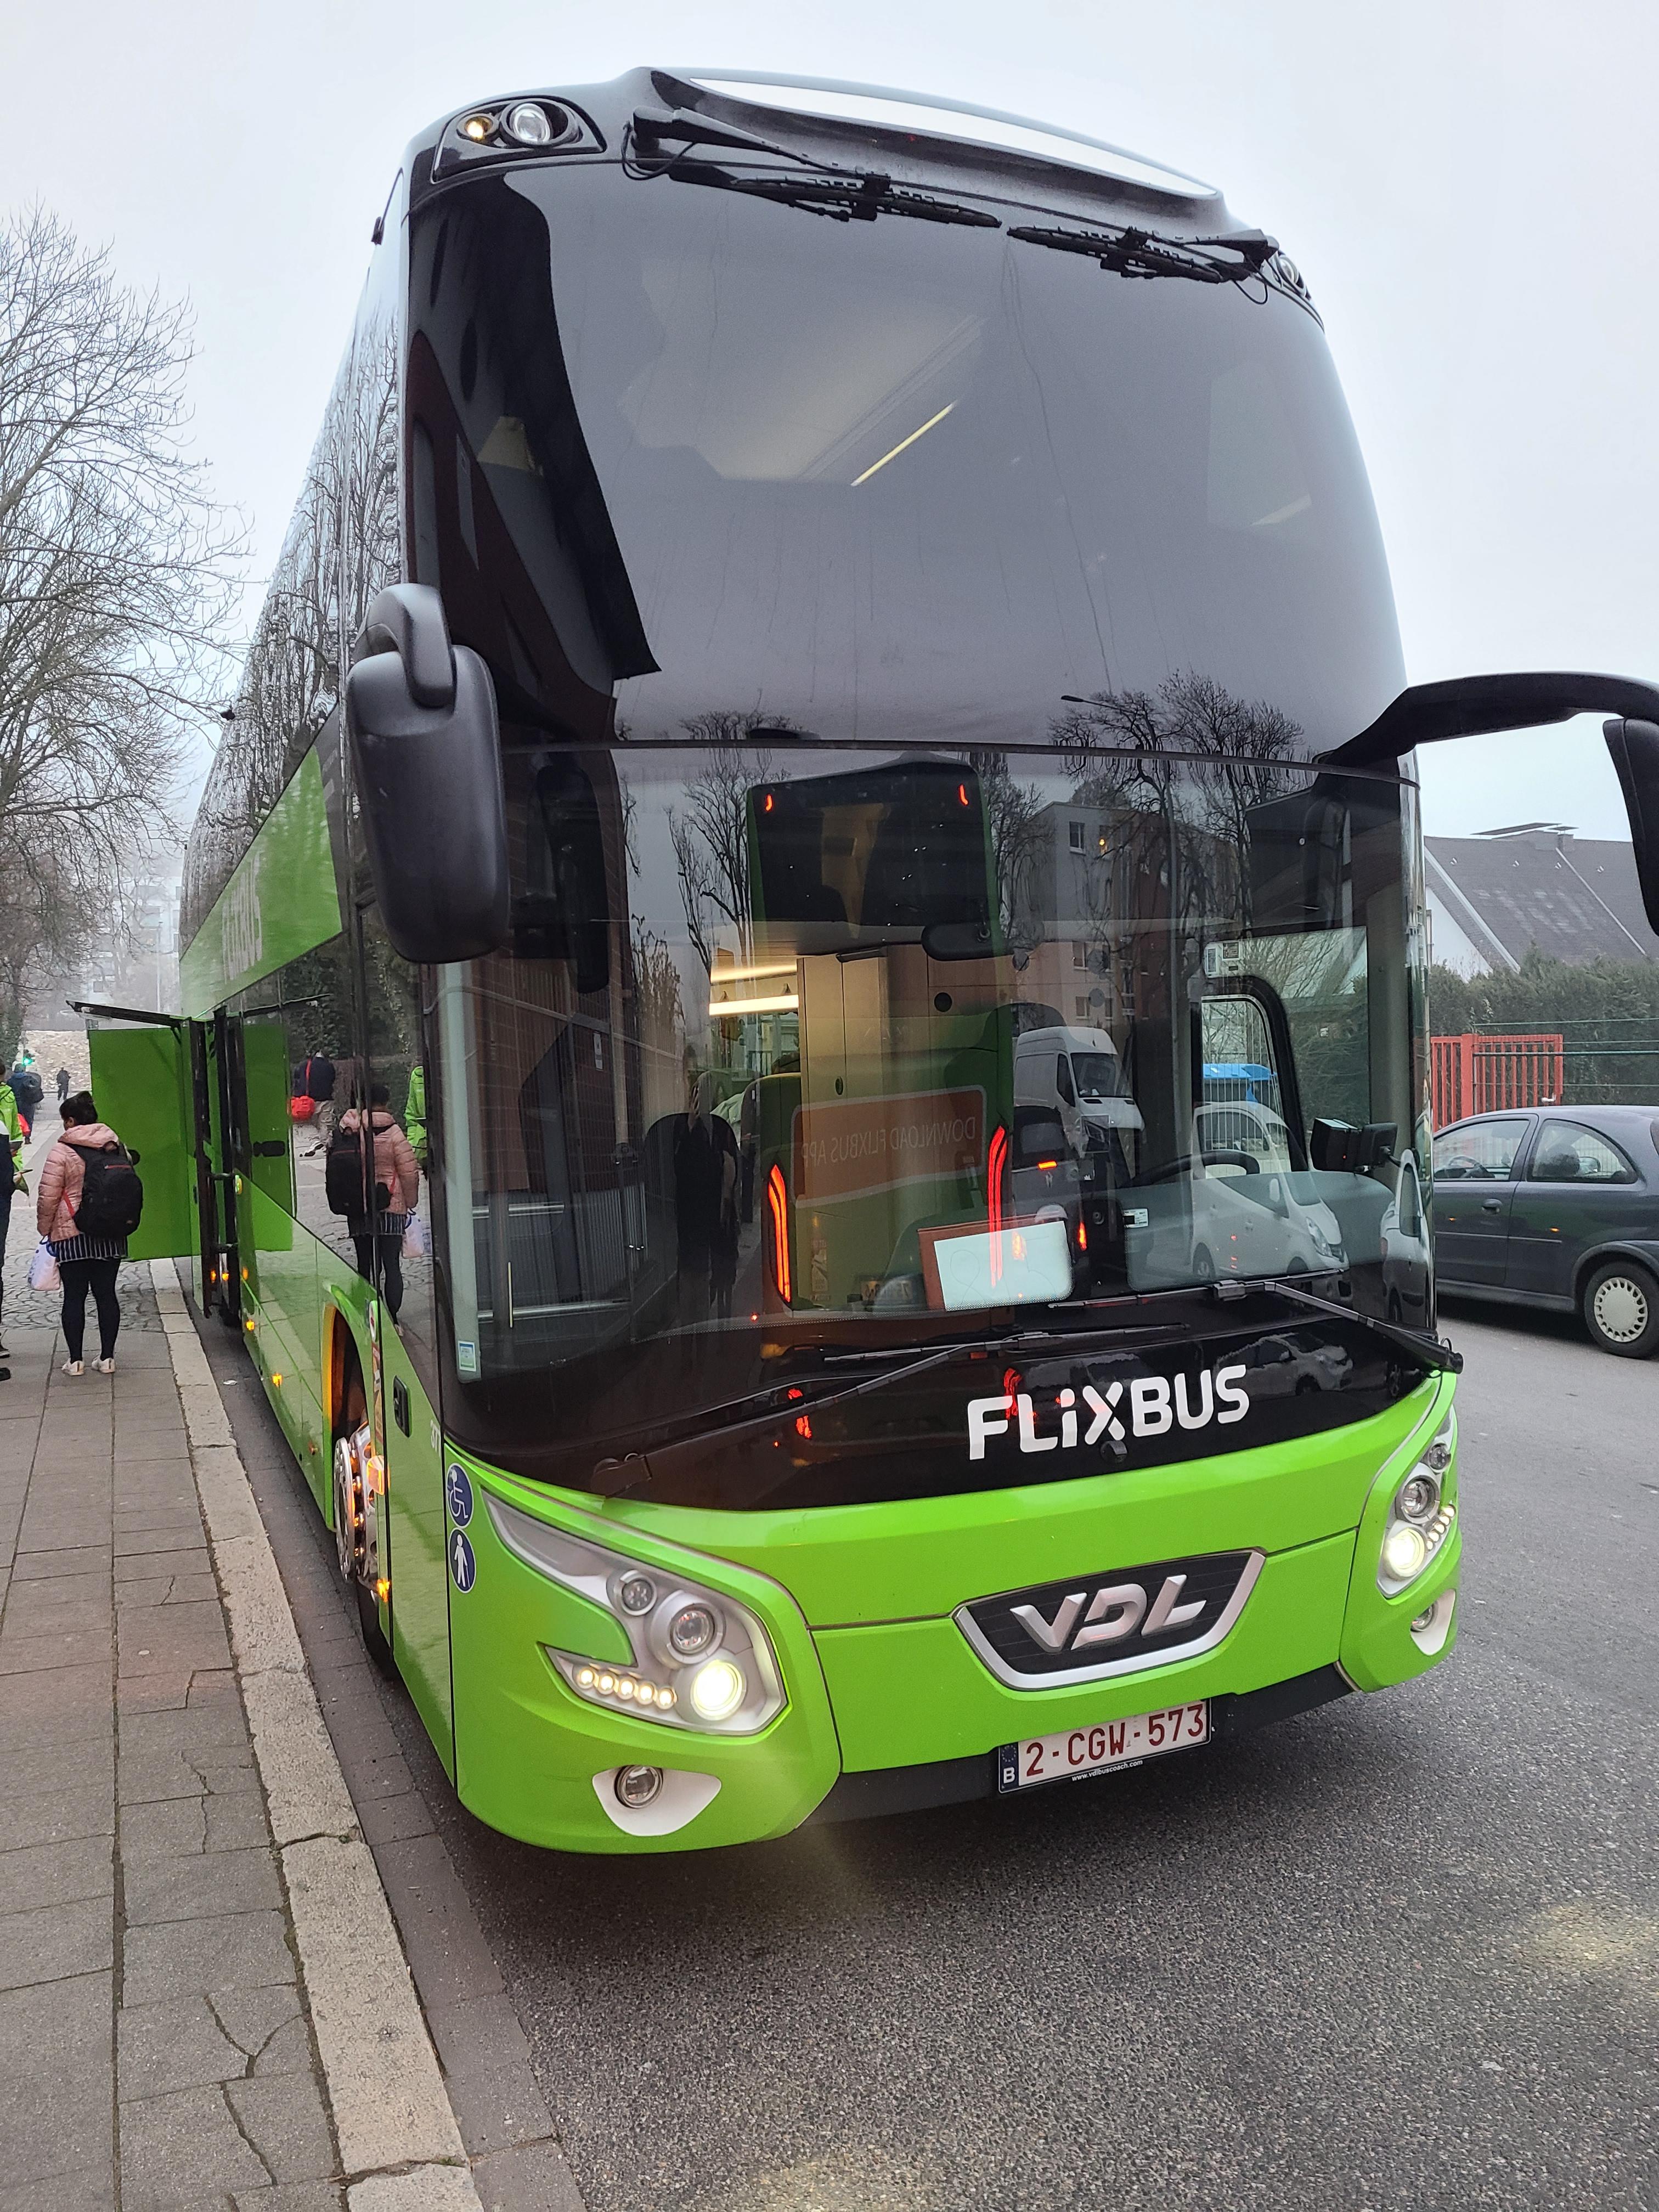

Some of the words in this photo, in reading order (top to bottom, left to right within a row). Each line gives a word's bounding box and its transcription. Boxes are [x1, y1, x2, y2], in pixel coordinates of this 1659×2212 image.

[1009, 1574, 1206, 1652] VDL
[1026, 1703, 1204, 1777] 2-CGW-573
[1003, 1767, 1015, 1784] B
[1071, 1759, 1143, 1781] www.vdlbuscoach.com
